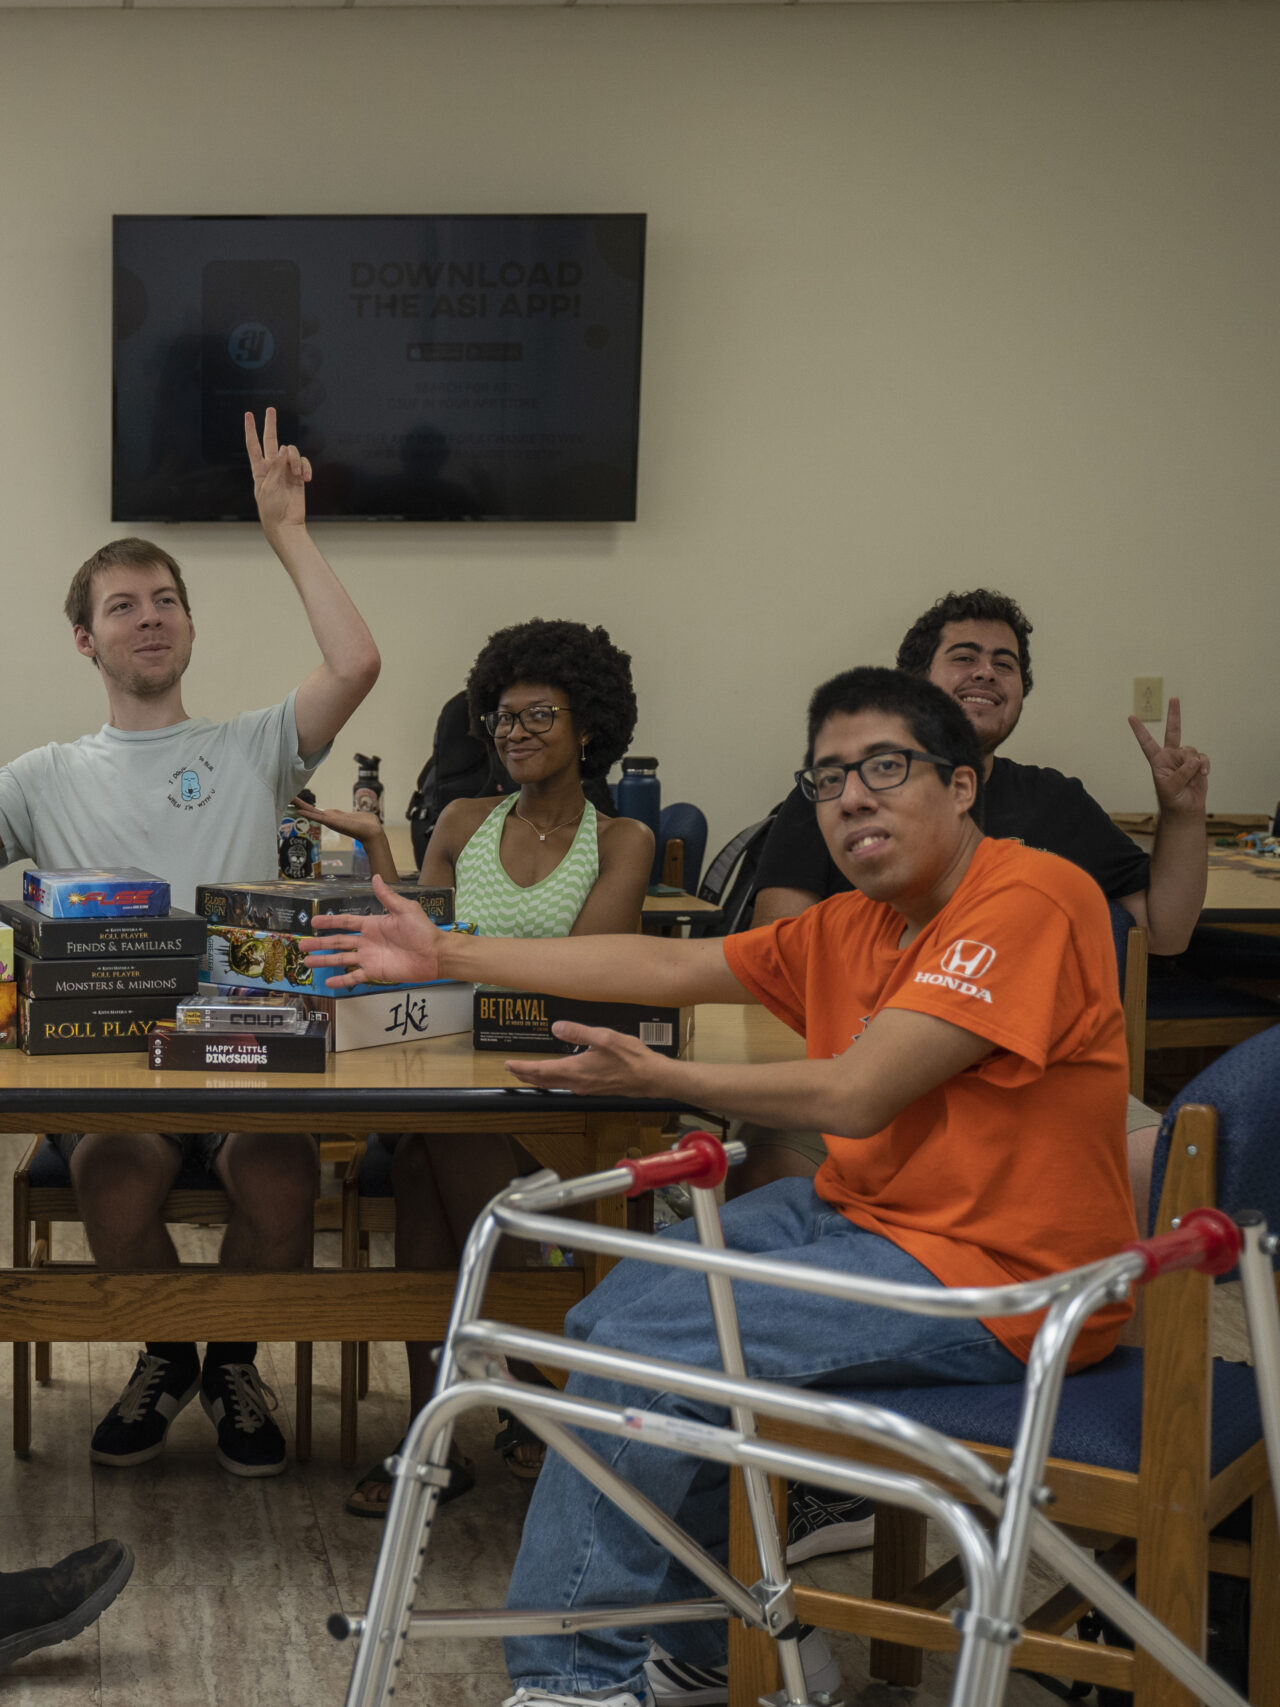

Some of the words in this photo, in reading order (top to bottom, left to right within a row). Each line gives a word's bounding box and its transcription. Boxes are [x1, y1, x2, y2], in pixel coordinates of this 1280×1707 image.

[350, 261, 582, 289] DOWNLOAD
[350, 293, 420, 318] THE
[431, 293, 487, 318] ASI
[499, 293, 581, 318] APP!
[81, 890, 154, 906] FUSE
[67, 942, 106, 953] FIENDS
[108, 942, 118, 951] &
[121, 939, 182, 951] FAMILIARS
[56, 980, 114, 992] MONSTERS
[116, 981, 125, 990] &
[128, 978, 177, 989] MINIONS
[914, 971, 993, 1004] HONDA
[480, 998, 548, 1026] BETRAYAL
[45, 1022, 96, 1039] ROLL
[103, 1020, 158, 1038] PLAY
[205, 1044, 234, 1054] HAPPY
[238, 1045, 268, 1054] LITTLE
[205, 1053, 268, 1064] DINOSAURS
